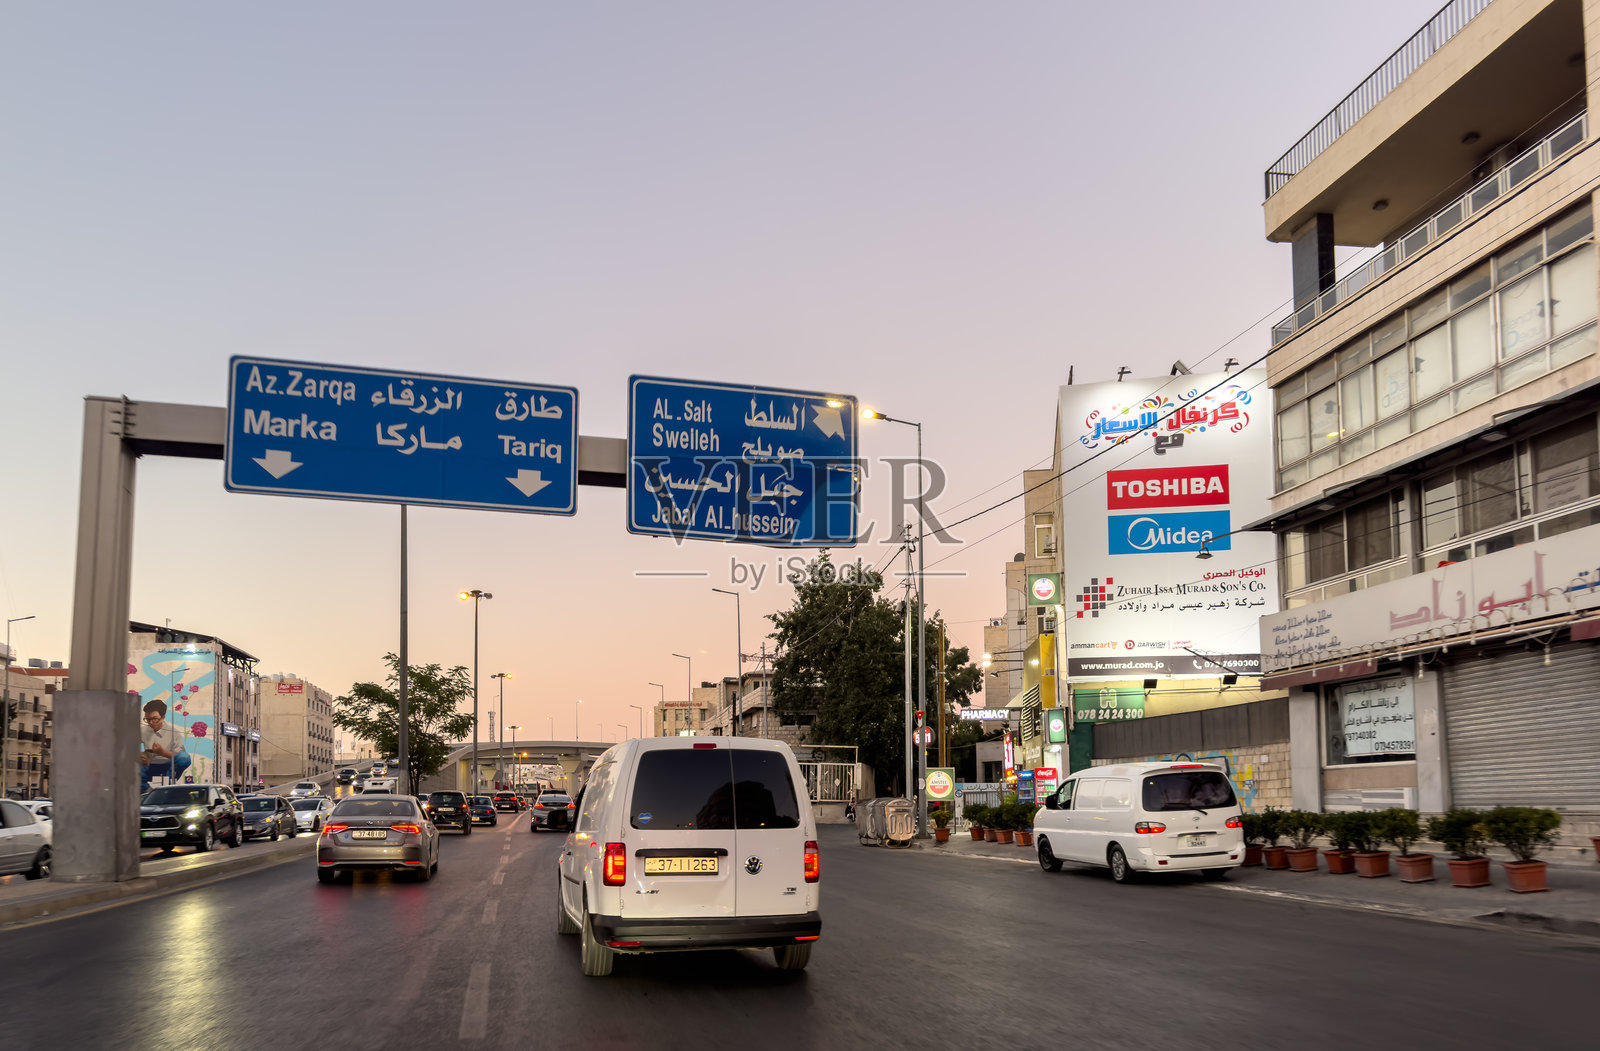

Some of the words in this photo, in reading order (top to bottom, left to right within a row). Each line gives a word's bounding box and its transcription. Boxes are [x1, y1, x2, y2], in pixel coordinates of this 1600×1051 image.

[371, 377, 462, 415] الزرقاء
[495, 391, 563, 421] طارق
[243, 407, 338, 442] Marka
[744, 398, 806, 431] السلط
[1166, 401, 1241, 431] كرنفال
[375, 421, 463, 455] ماركا
[497, 434, 563, 464] Tariq
[1153, 432, 1185, 456] مع
[741, 436, 805, 465] صويلح
[645, 467, 741, 499] الحسين
[746, 472, 804, 505] جبل
[1112, 476, 1224, 499] TOSHIBA
[652, 499, 696, 527] Jabal
[1140, 526, 1214, 546] Midea
[1203, 569, 1235, 581] الحصري
[1237, 567, 1266, 579] الوكيل
[1151, 602, 1175, 611] مراد
[1179, 601, 1204, 611] عيسى
[1207, 598, 1230, 611] زهير
[1234, 597, 1266, 609] شركة
[1071, 641, 1111, 650] ammancart
[1081, 661, 1165, 671] www.murad.com.jo
[961, 709, 1009, 720] PHARMACY
[1077, 709, 1096, 720] 078
